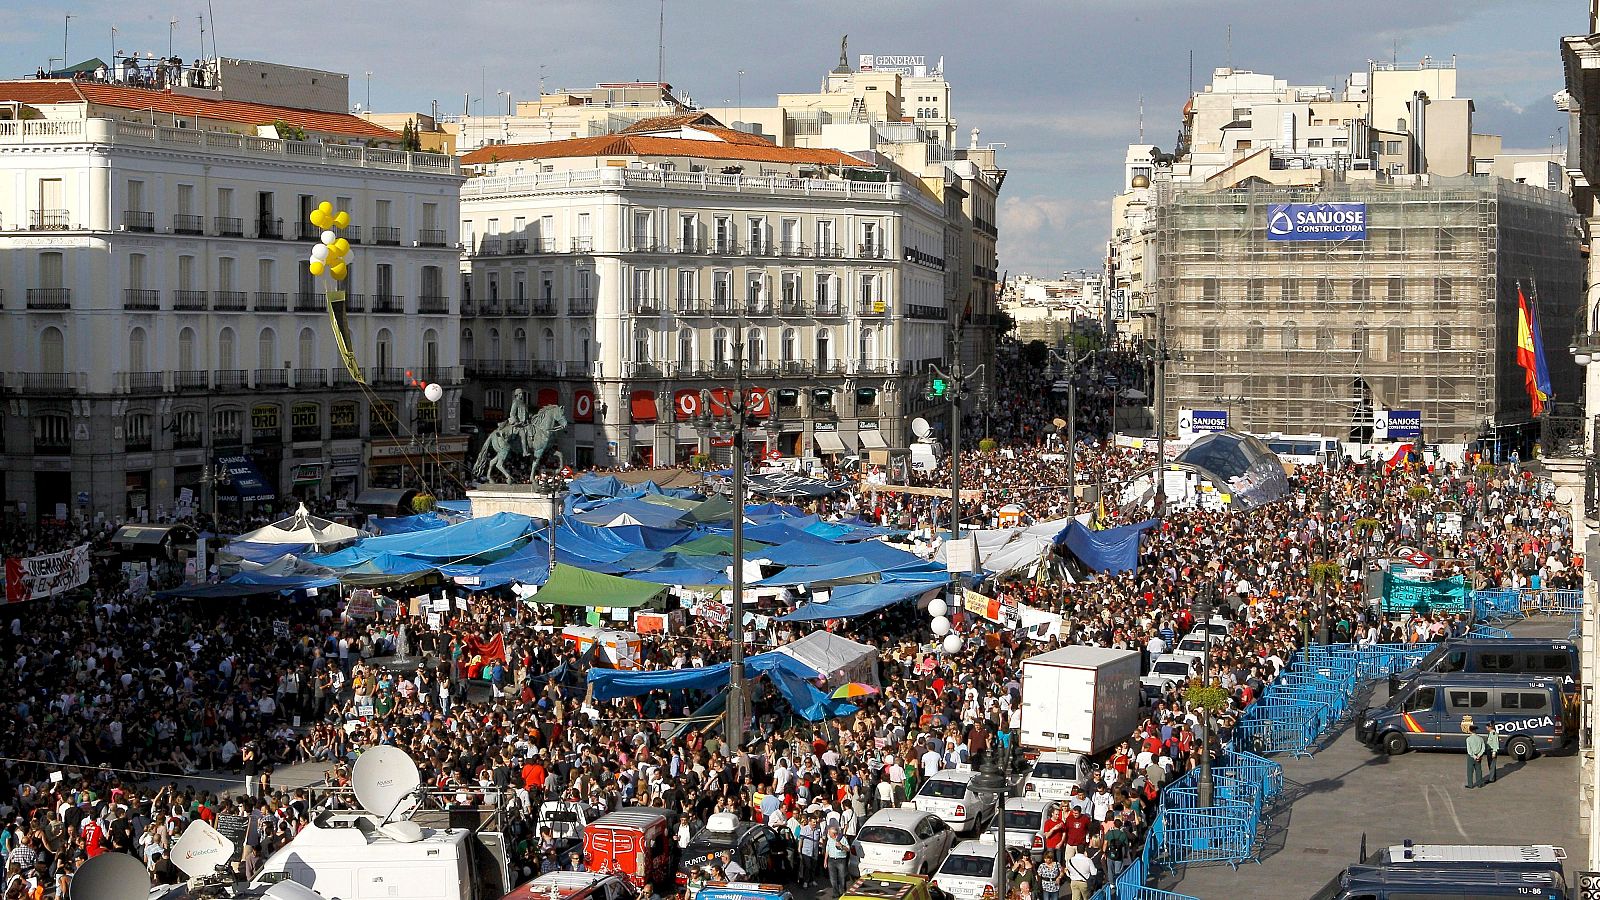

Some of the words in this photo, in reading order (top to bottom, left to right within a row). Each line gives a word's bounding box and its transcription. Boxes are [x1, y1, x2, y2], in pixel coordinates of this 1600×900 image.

[875, 55, 925, 66] GENERALI
[1296, 211, 1364, 224] SANJOSE
[252, 407, 277, 415] COMPRO
[291, 405, 317, 413] COMPRO
[330, 404, 355, 412] COMPRO
[251, 415, 277, 428] ORO
[291, 413, 317, 426] ORO
[330, 412, 355, 424] ORO
[369, 411, 394, 423] ORO
[1192, 417, 1226, 426] SANJOSE
[218, 456, 247, 464] CHANGE
[1494, 715, 1554, 734] POLICIA
[684, 855, 707, 867] PUNTO
[714, 848, 736, 859] RAO
[1518, 887, 1542, 895] 1U-86
